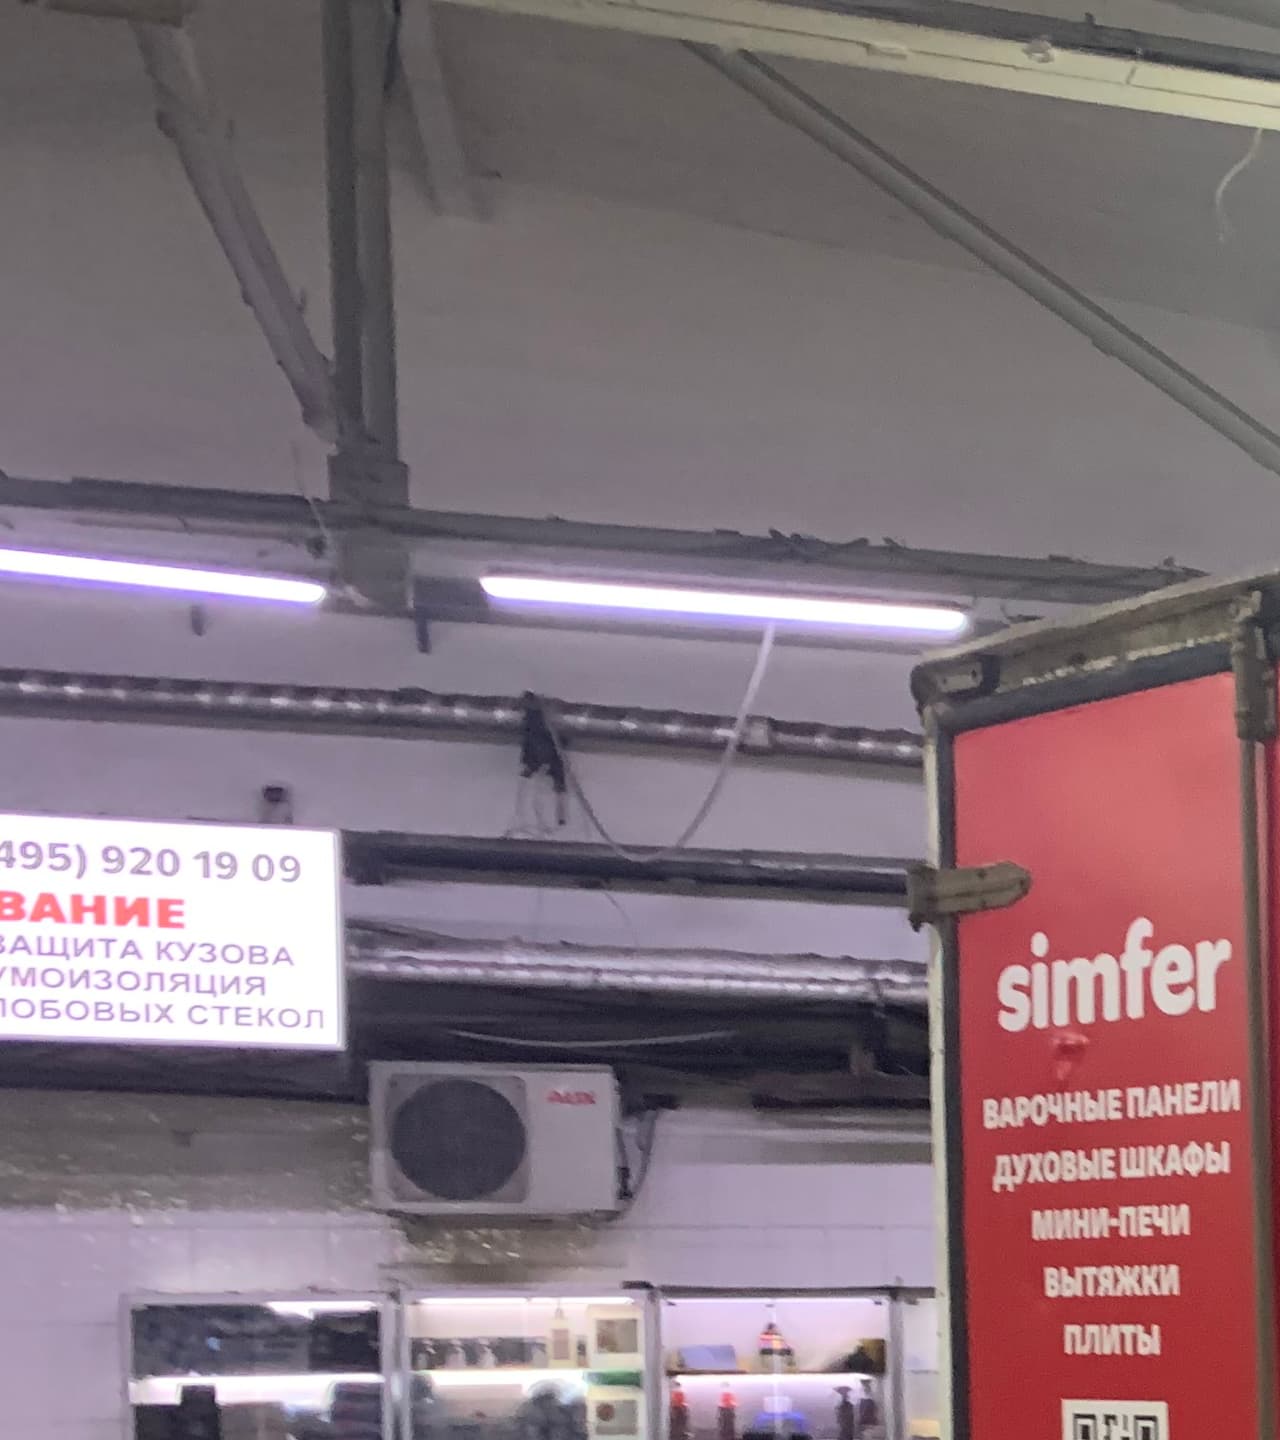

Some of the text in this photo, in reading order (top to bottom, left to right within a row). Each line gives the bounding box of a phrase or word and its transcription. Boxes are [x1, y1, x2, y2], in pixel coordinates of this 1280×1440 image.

[101, 846, 181, 877] 920
[192, 851, 238, 880] 19
[252, 854, 302, 883] 09
[0, 890, 186, 929] ВАНИЕ
[156, 941, 295, 967] КУЗОВА
[998, 917, 1233, 1032] simfer
[187, 1004, 325, 1030] СТЕКОЛ
[982, 1079, 1242, 1130] ВАРОЧНЫЕ ПАНЕЛИ
[992, 1141, 1231, 1193] ДУХОВЫЕ ШКАФЫ
[1031, 1203, 1191, 1241] МИНИ-ПЕЧИ
[1043, 1263, 1181, 1298] ВЫТЯЖКИ
[1063, 1323, 1162, 1356] ПЛИТЫ
